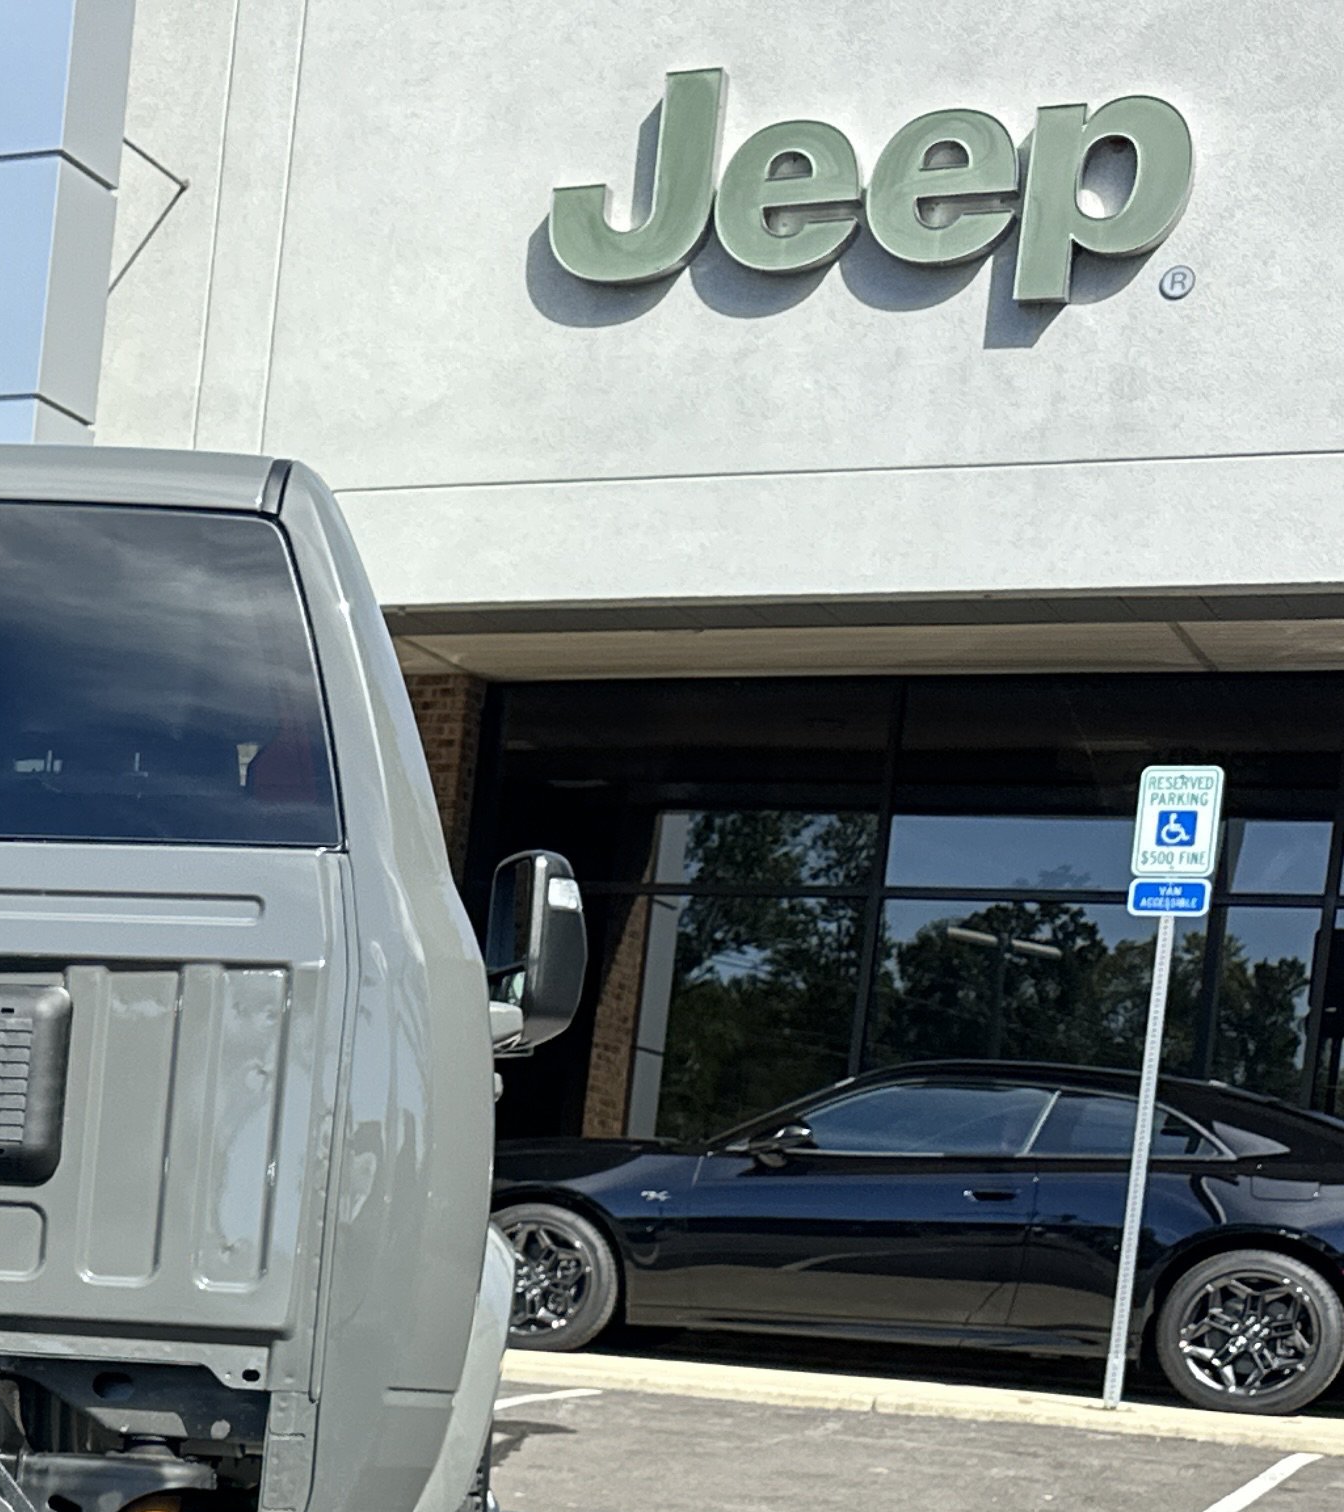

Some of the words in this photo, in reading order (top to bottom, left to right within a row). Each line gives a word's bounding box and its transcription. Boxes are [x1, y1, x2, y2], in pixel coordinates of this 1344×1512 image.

[548, 66, 1196, 303] Jeep
[1148, 775, 1214, 790] RESERVED
[1150, 792, 1209, 806] PARKING
[1141, 850, 1174, 865] $500
[1178, 850, 1206, 865] FINE
